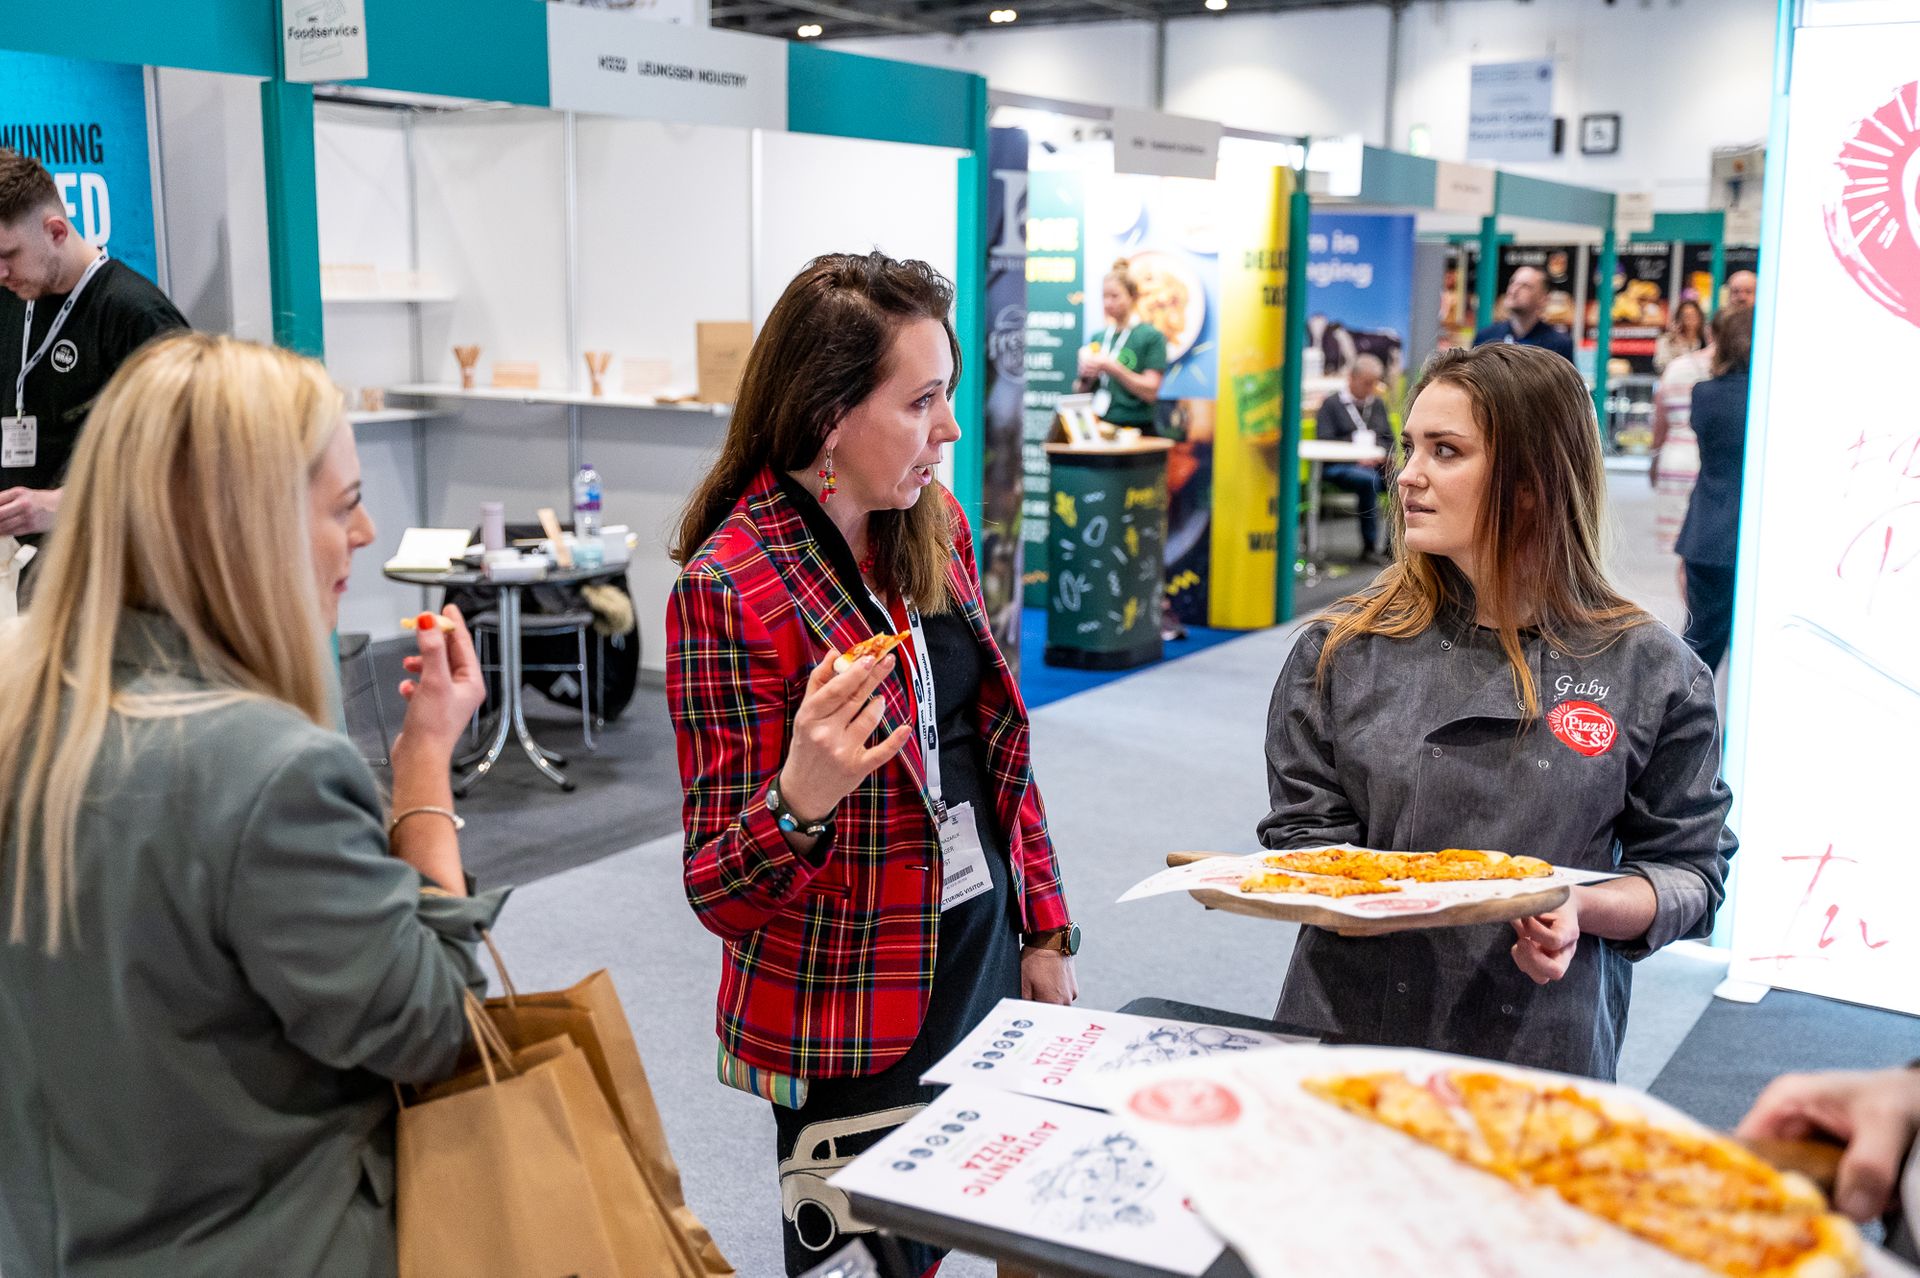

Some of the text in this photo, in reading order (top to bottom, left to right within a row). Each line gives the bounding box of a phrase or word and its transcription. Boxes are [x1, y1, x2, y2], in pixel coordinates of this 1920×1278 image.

[0, 123, 104, 165] WINNING
[1555, 675, 1610, 701] Gaby
[1567, 716, 1608, 732] Pizza
[943, 845, 955, 855] GER
[941, 890, 964, 906] CTURING
[963, 880, 985, 895] VISITOR
[1032, 1036, 1073, 1066] PIZZA
[1042, 1023, 1107, 1085] AUTHENTIC
[960, 1134, 1018, 1171] PIZZA
[962, 1121, 1059, 1196] AUTHENTIC
